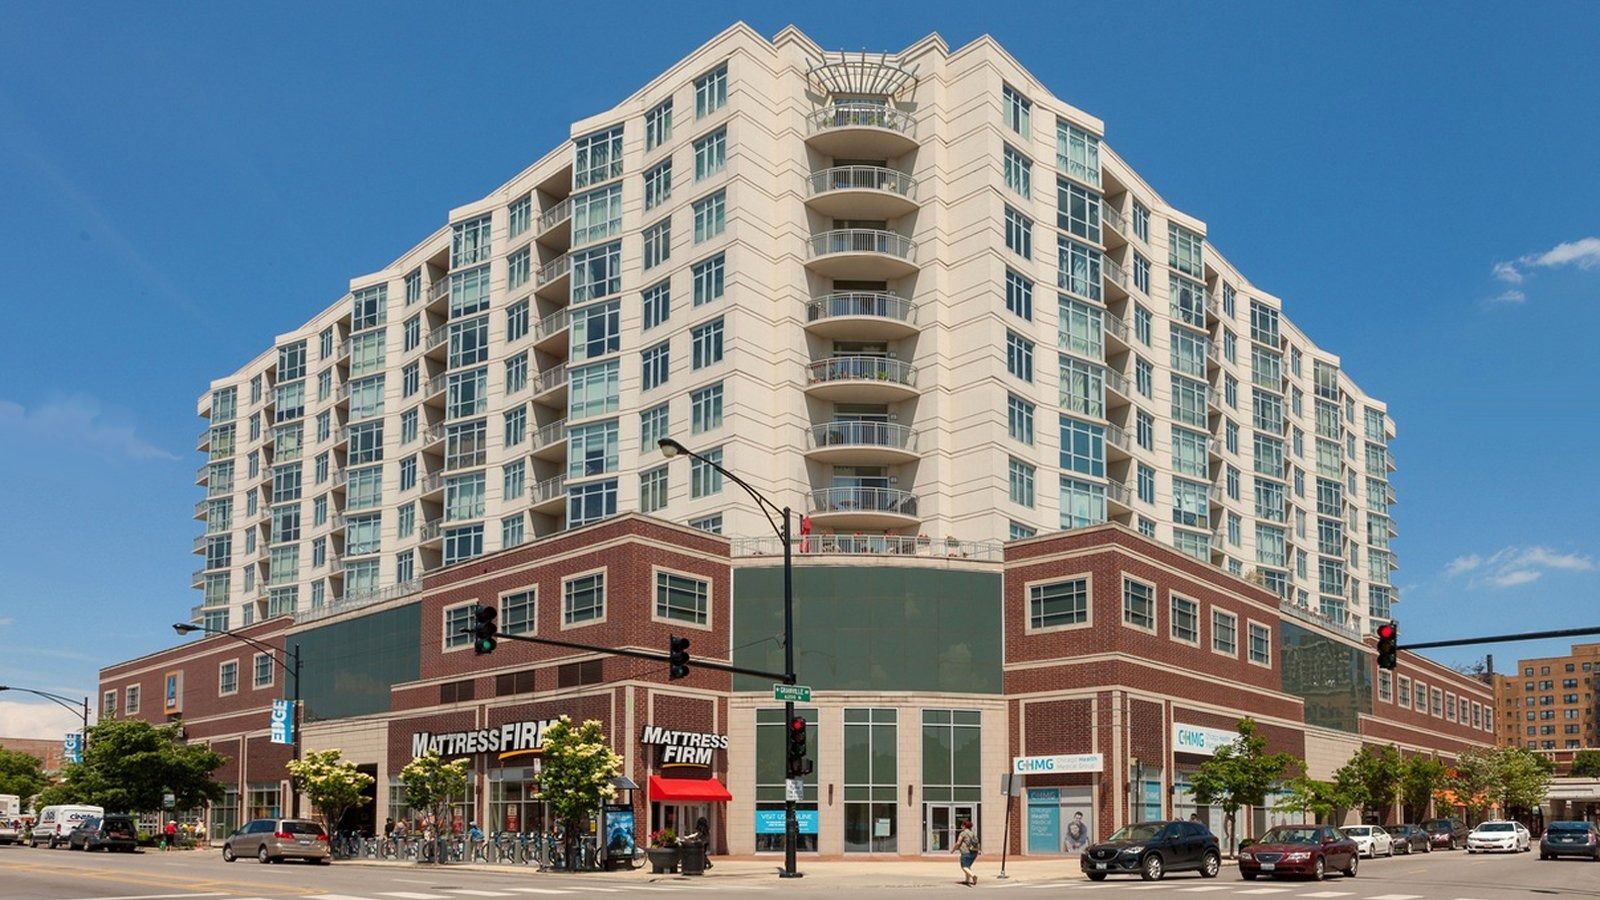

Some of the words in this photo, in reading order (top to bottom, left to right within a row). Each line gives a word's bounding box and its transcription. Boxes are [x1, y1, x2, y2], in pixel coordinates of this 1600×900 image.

[270, 699, 288, 743] EDGE
[412, 728, 500, 758] MATTRESS
[641, 726, 729, 749] MATTRESS
[663, 745, 713, 765] FIRM
